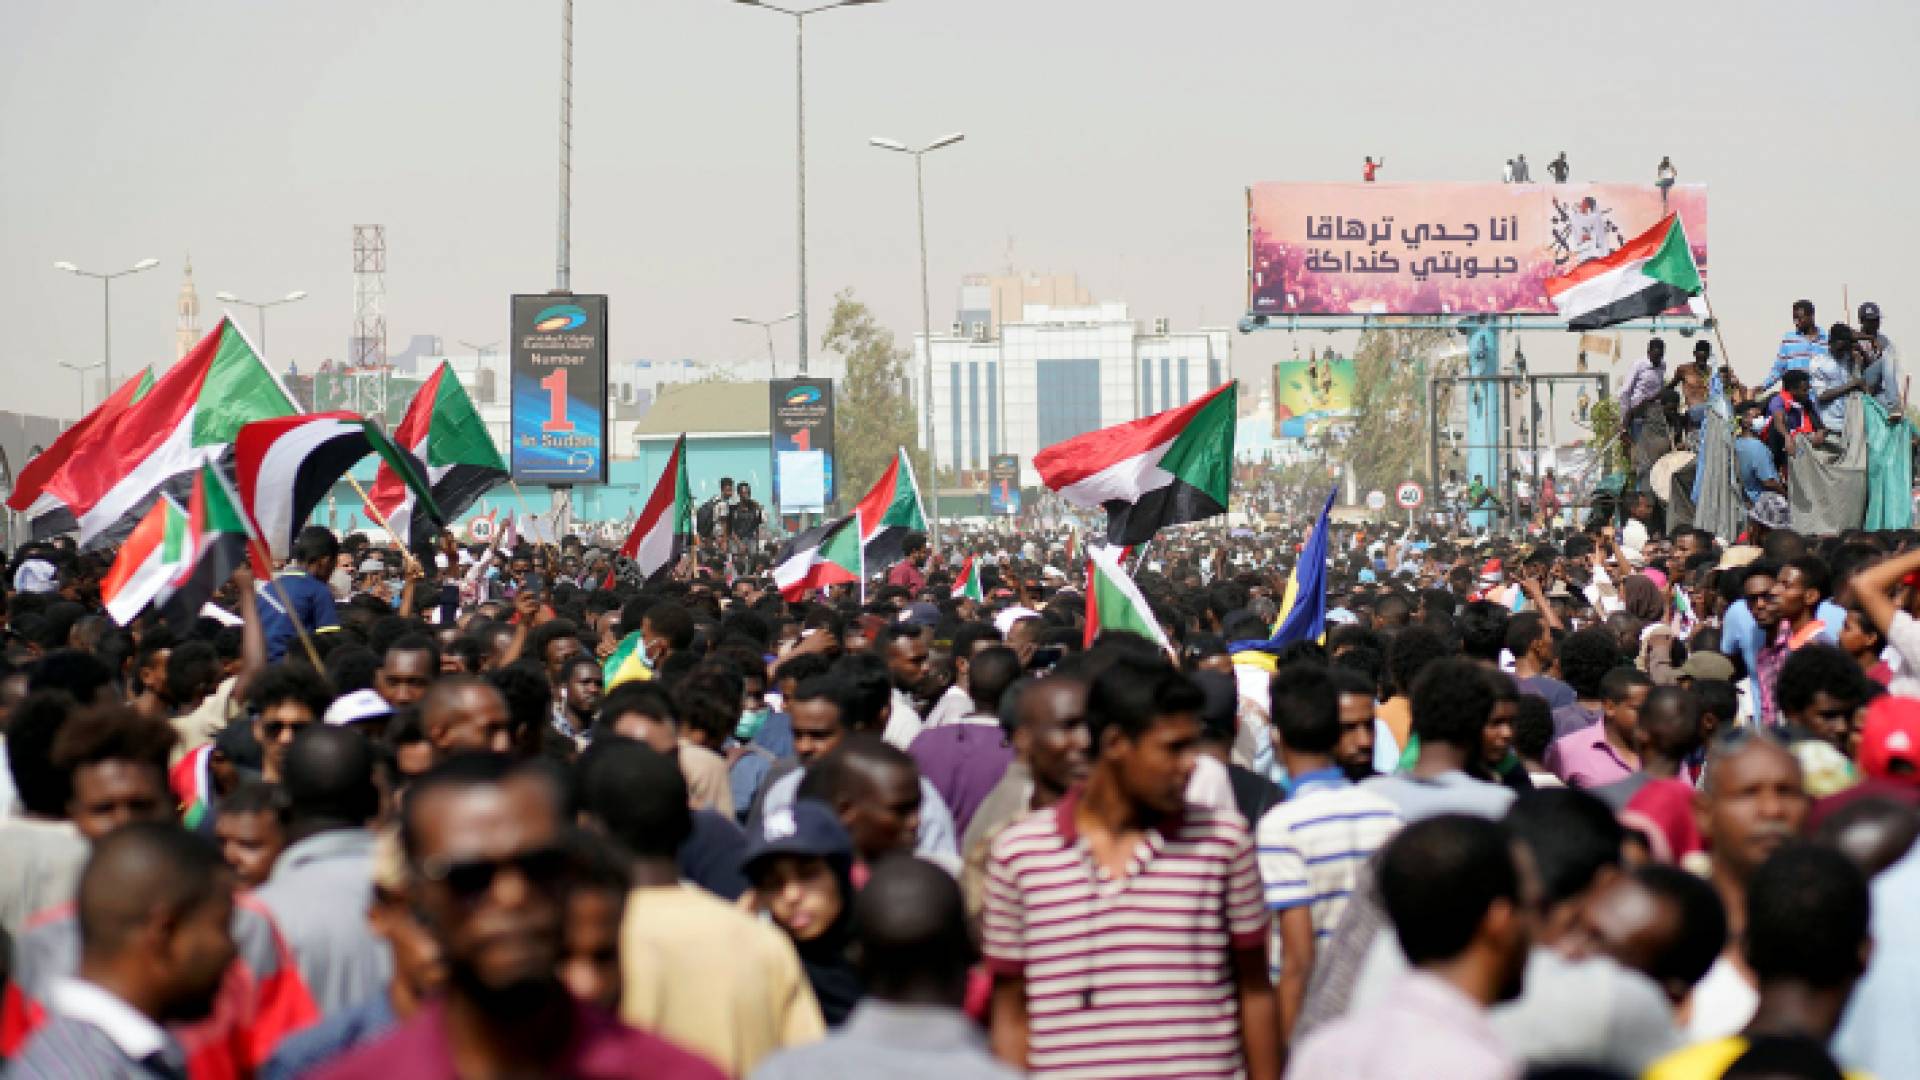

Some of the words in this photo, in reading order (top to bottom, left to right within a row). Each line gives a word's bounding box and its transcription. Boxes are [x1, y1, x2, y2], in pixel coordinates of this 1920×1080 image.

[1306, 215, 1395, 246] ترهاقا
[1305, 248, 1400, 273] كنداكة
[531, 353, 585, 365] Number
[541, 367, 575, 431] 1
[542, 432, 595, 448] Sudan
[1401, 489, 1419, 502] 40
